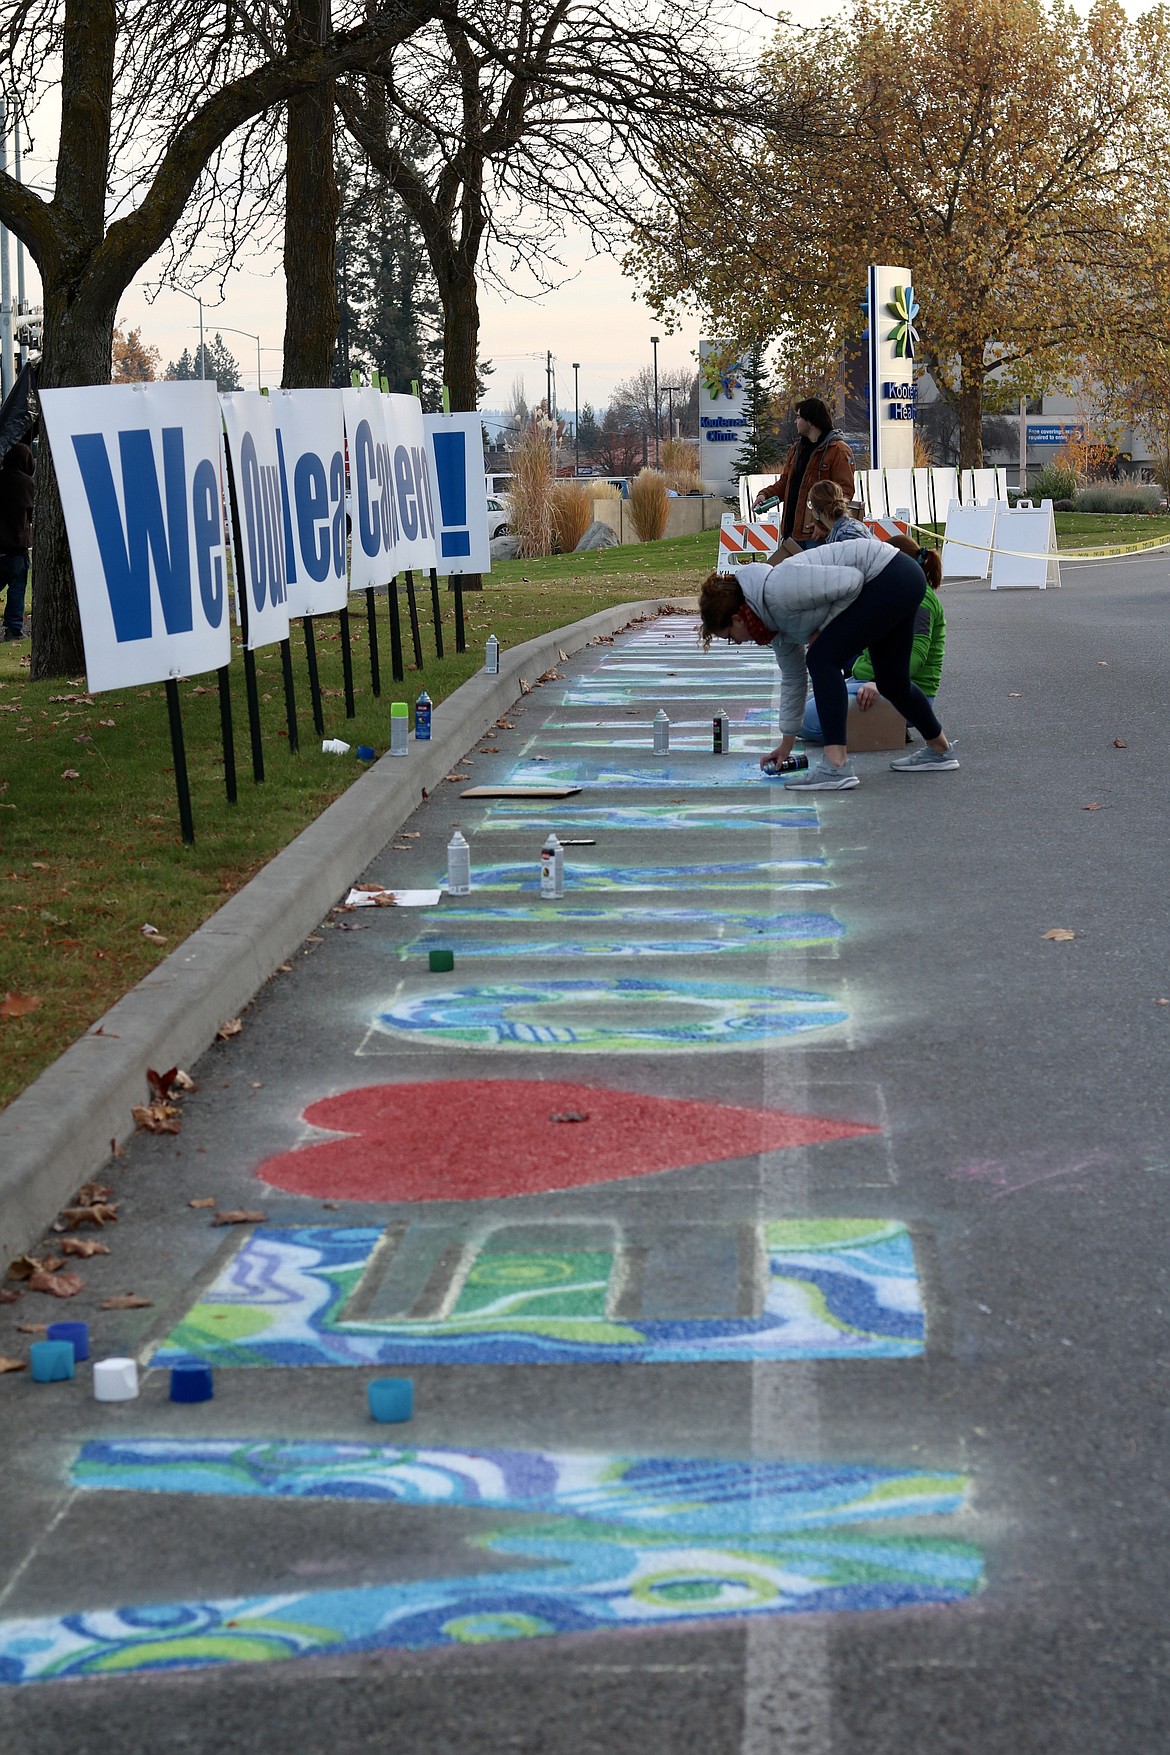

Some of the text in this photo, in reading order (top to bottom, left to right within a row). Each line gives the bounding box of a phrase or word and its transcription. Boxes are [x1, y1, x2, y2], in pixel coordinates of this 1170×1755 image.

[706, 430, 738, 442] Clinic
[71, 427, 223, 643] We
[240, 430, 288, 613] Our
